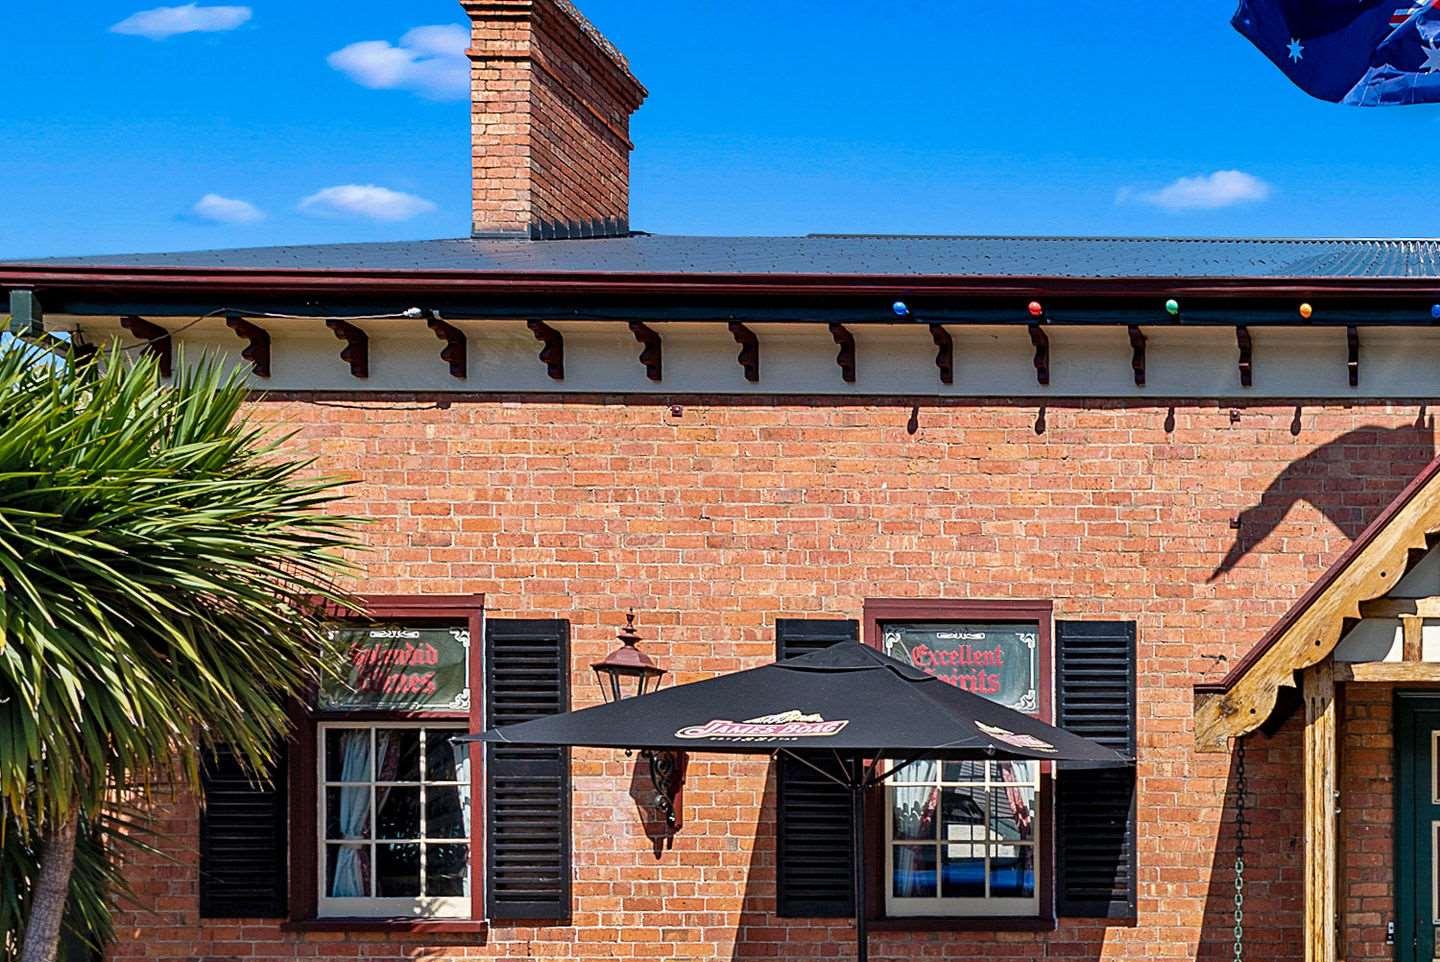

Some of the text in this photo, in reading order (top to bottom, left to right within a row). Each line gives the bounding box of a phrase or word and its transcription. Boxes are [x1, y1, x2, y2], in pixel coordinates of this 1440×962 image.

[911, 643, 1005, 668] Excellent
[923, 668, 1001, 695] irits
[782, 722, 840, 734] BOAG
